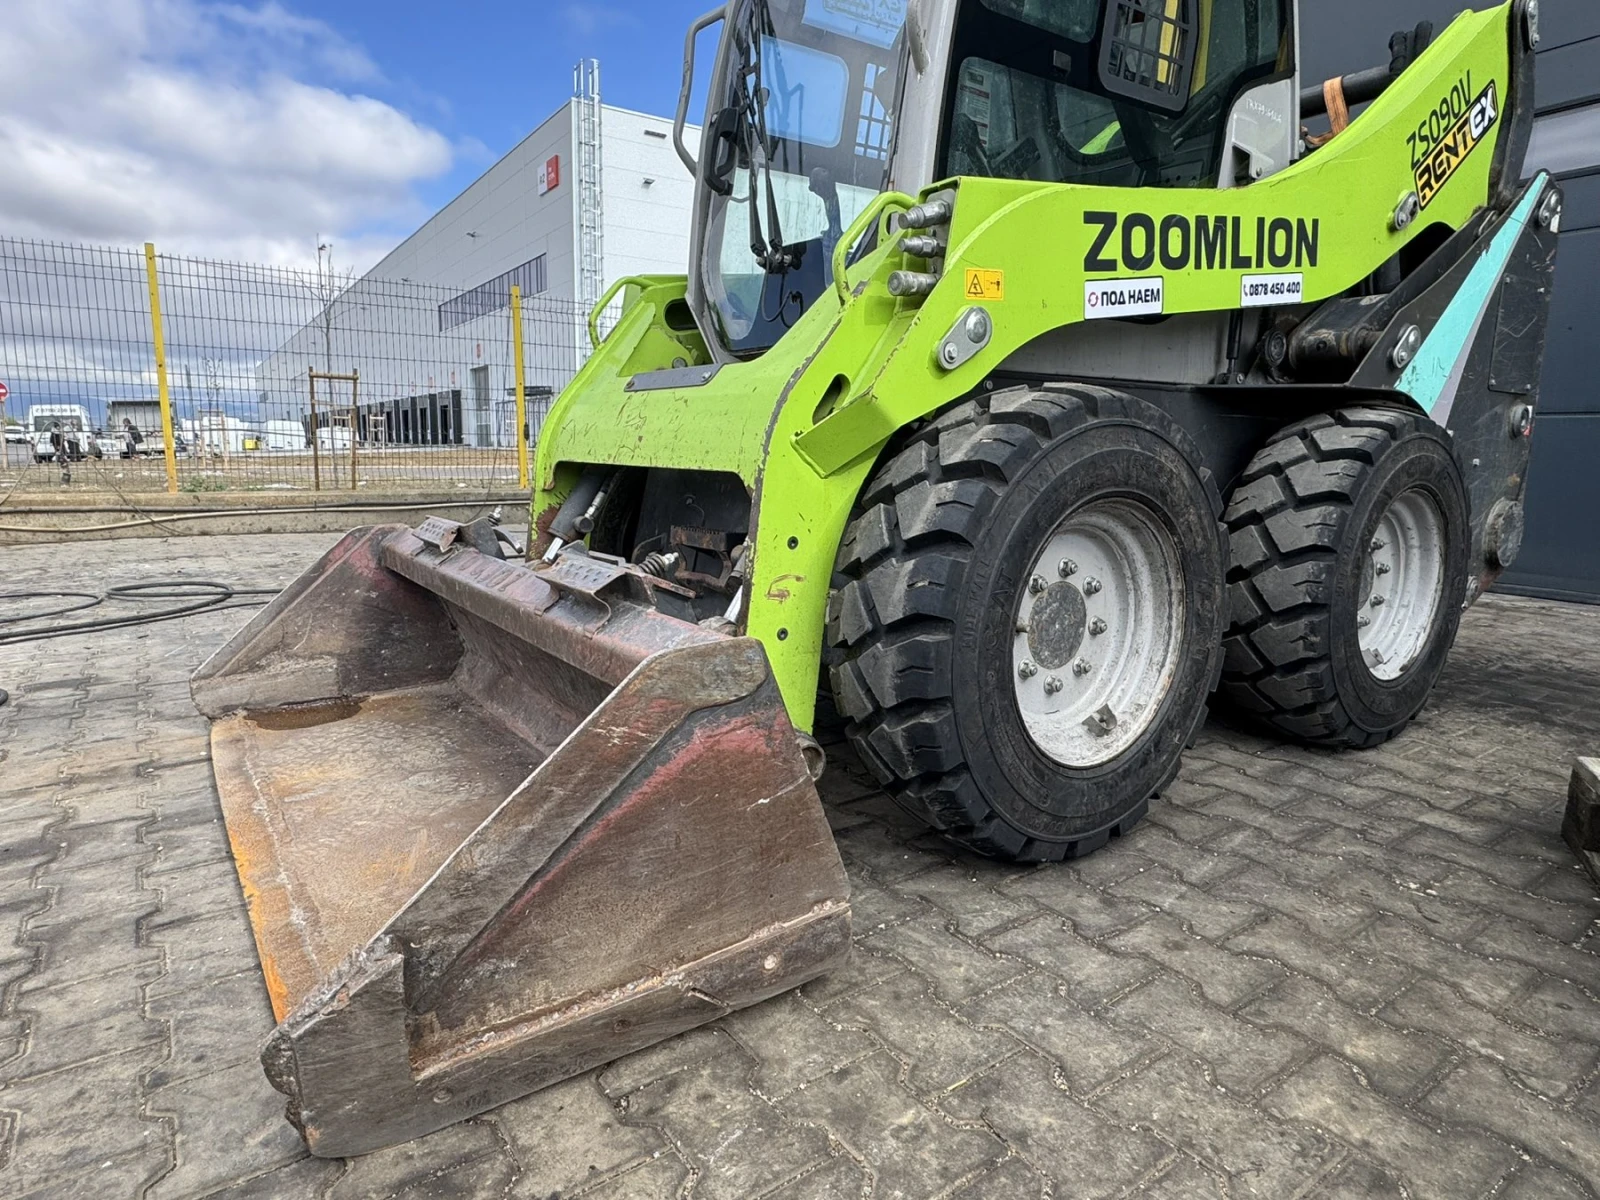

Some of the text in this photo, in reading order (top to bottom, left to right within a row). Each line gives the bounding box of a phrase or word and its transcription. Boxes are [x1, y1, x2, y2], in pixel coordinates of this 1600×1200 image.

[1405, 69, 1472, 172] ZS090V
[1417, 86, 1497, 203] RENTEX
[1083, 211, 1319, 272] ZOOMLION
[1101, 287, 1160, 307] ПОД НАЕМ
[1249, 281, 1300, 296] 0878 450 400
